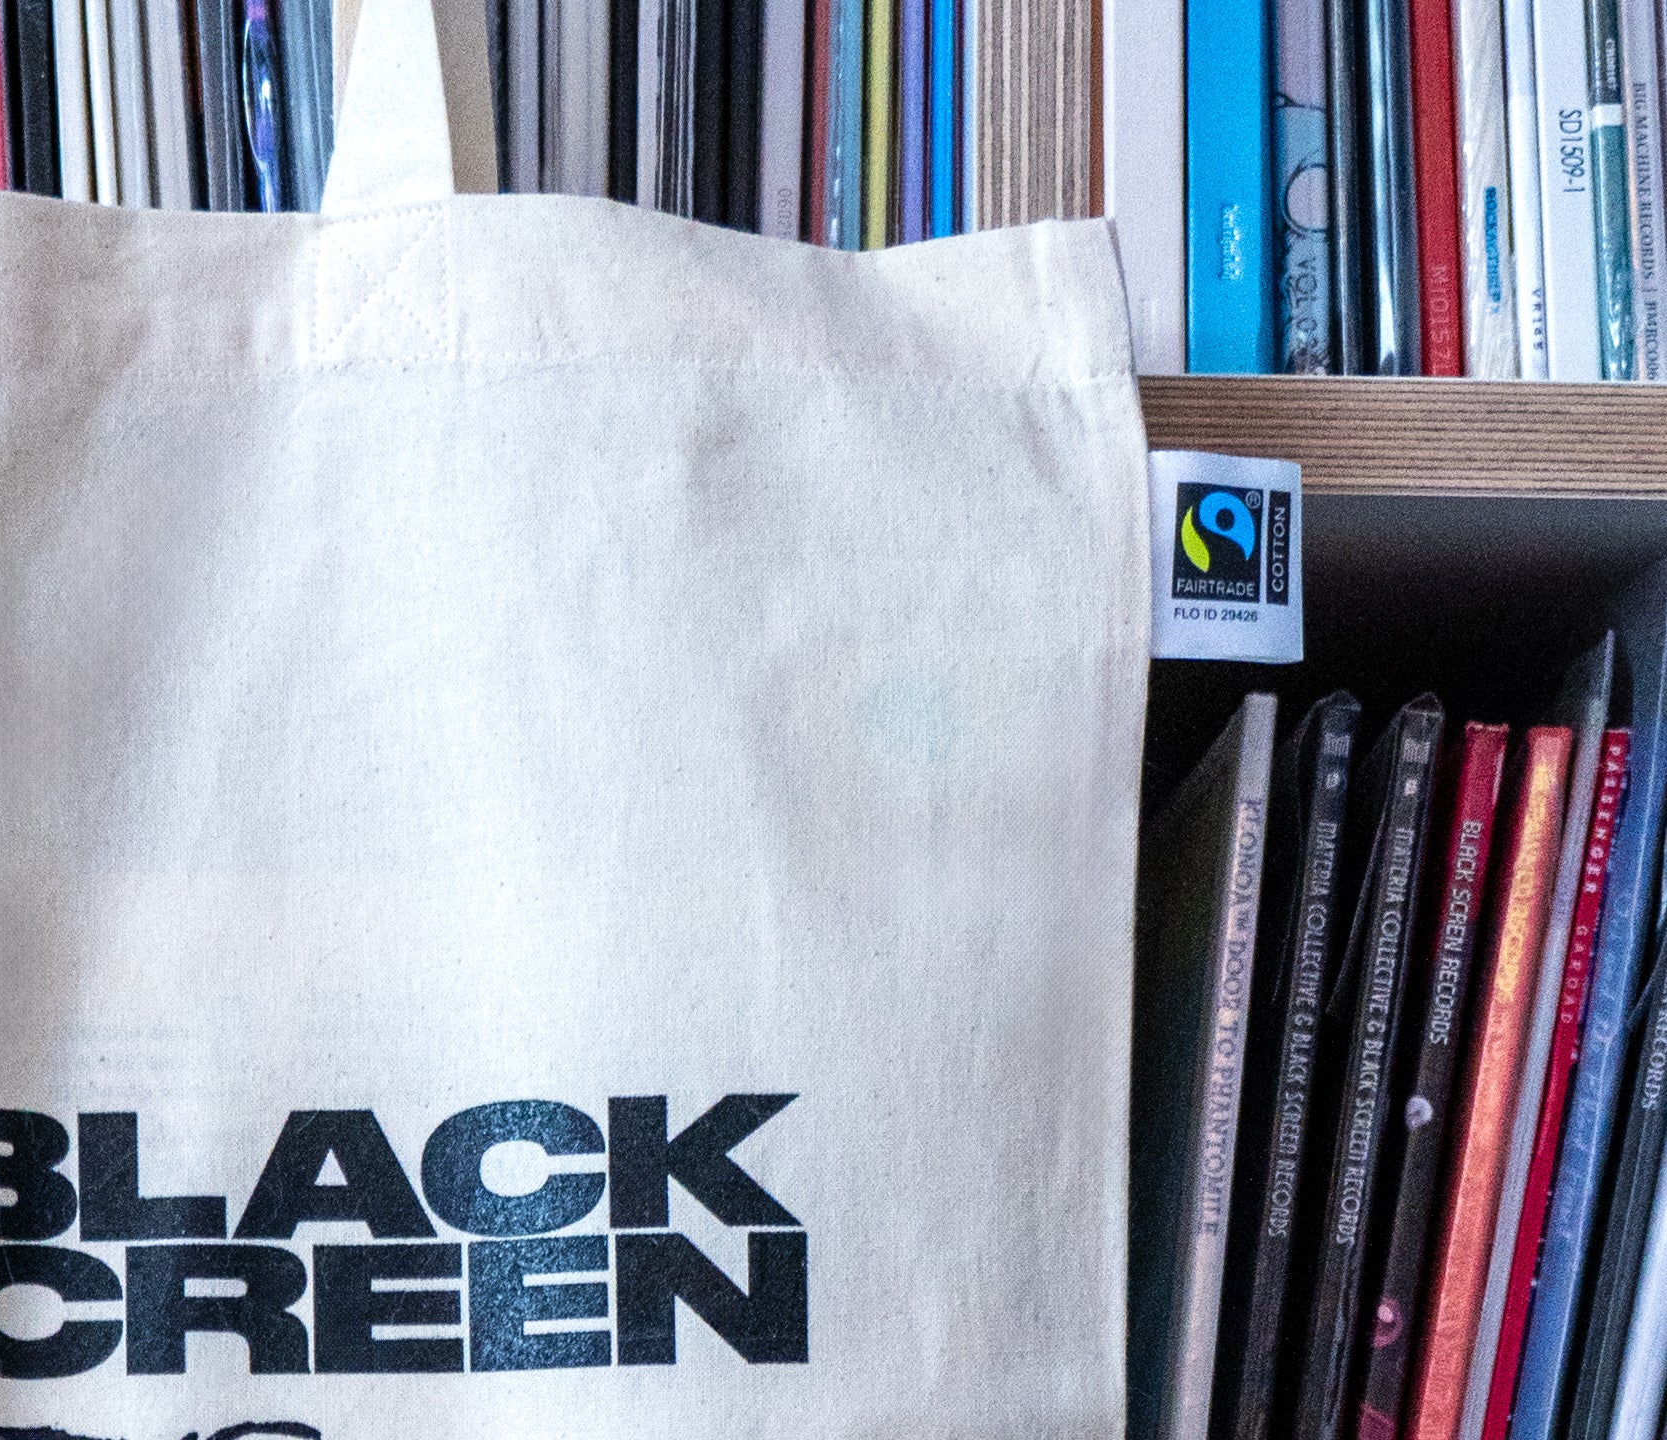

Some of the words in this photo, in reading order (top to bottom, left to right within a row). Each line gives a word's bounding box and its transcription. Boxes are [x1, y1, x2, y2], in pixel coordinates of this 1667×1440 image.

[1633, 82, 1648, 110] BIG
[1559, 109, 1586, 194] SD1509-1
[1635, 116, 1652, 196] MACHINE
[1639, 202, 1655, 280] RECORDS
[1175, 577, 1257, 598] FAIRTRADE
[1271, 506, 1286, 593] COTTON
[1173, 606, 1200, 620] FLO
[1204, 608, 1217, 621] ID
[1220, 609, 1258, 623] 29426
[1455, 819, 1482, 883] BLACK
[1584, 745, 1622, 894] PASSENGER
[1310, 822, 1339, 895] MATERIA
[1385, 828, 1416, 902] MATERIA
[1294, 903, 1327, 1008] COLLECTIVE
[1368, 910, 1403, 1013] COLLECTIVE
[1560, 925, 1590, 1024] GAROAD
[1214, 1019, 1239, 1058] TO
[1293, 1013, 1314, 1026] &
[1366, 1019, 1386, 1033] &
[1430, 956, 1462, 1046] RECORDS
[1285, 1031, 1315, 1084] BLACK
[1355, 1040, 1383, 1092] BLACK
[1641, 1012, 1667, 1110] RECORDS
[1197, 1066, 1235, 1237] PHANTOMILE
[1278, 1091, 1305, 1155] SCREEN
[1347, 1097, 1375, 1160] SCREEN
[1266, 1159, 1296, 1238] RECORDS
[1334, 1166, 1365, 1245] RECORDS
